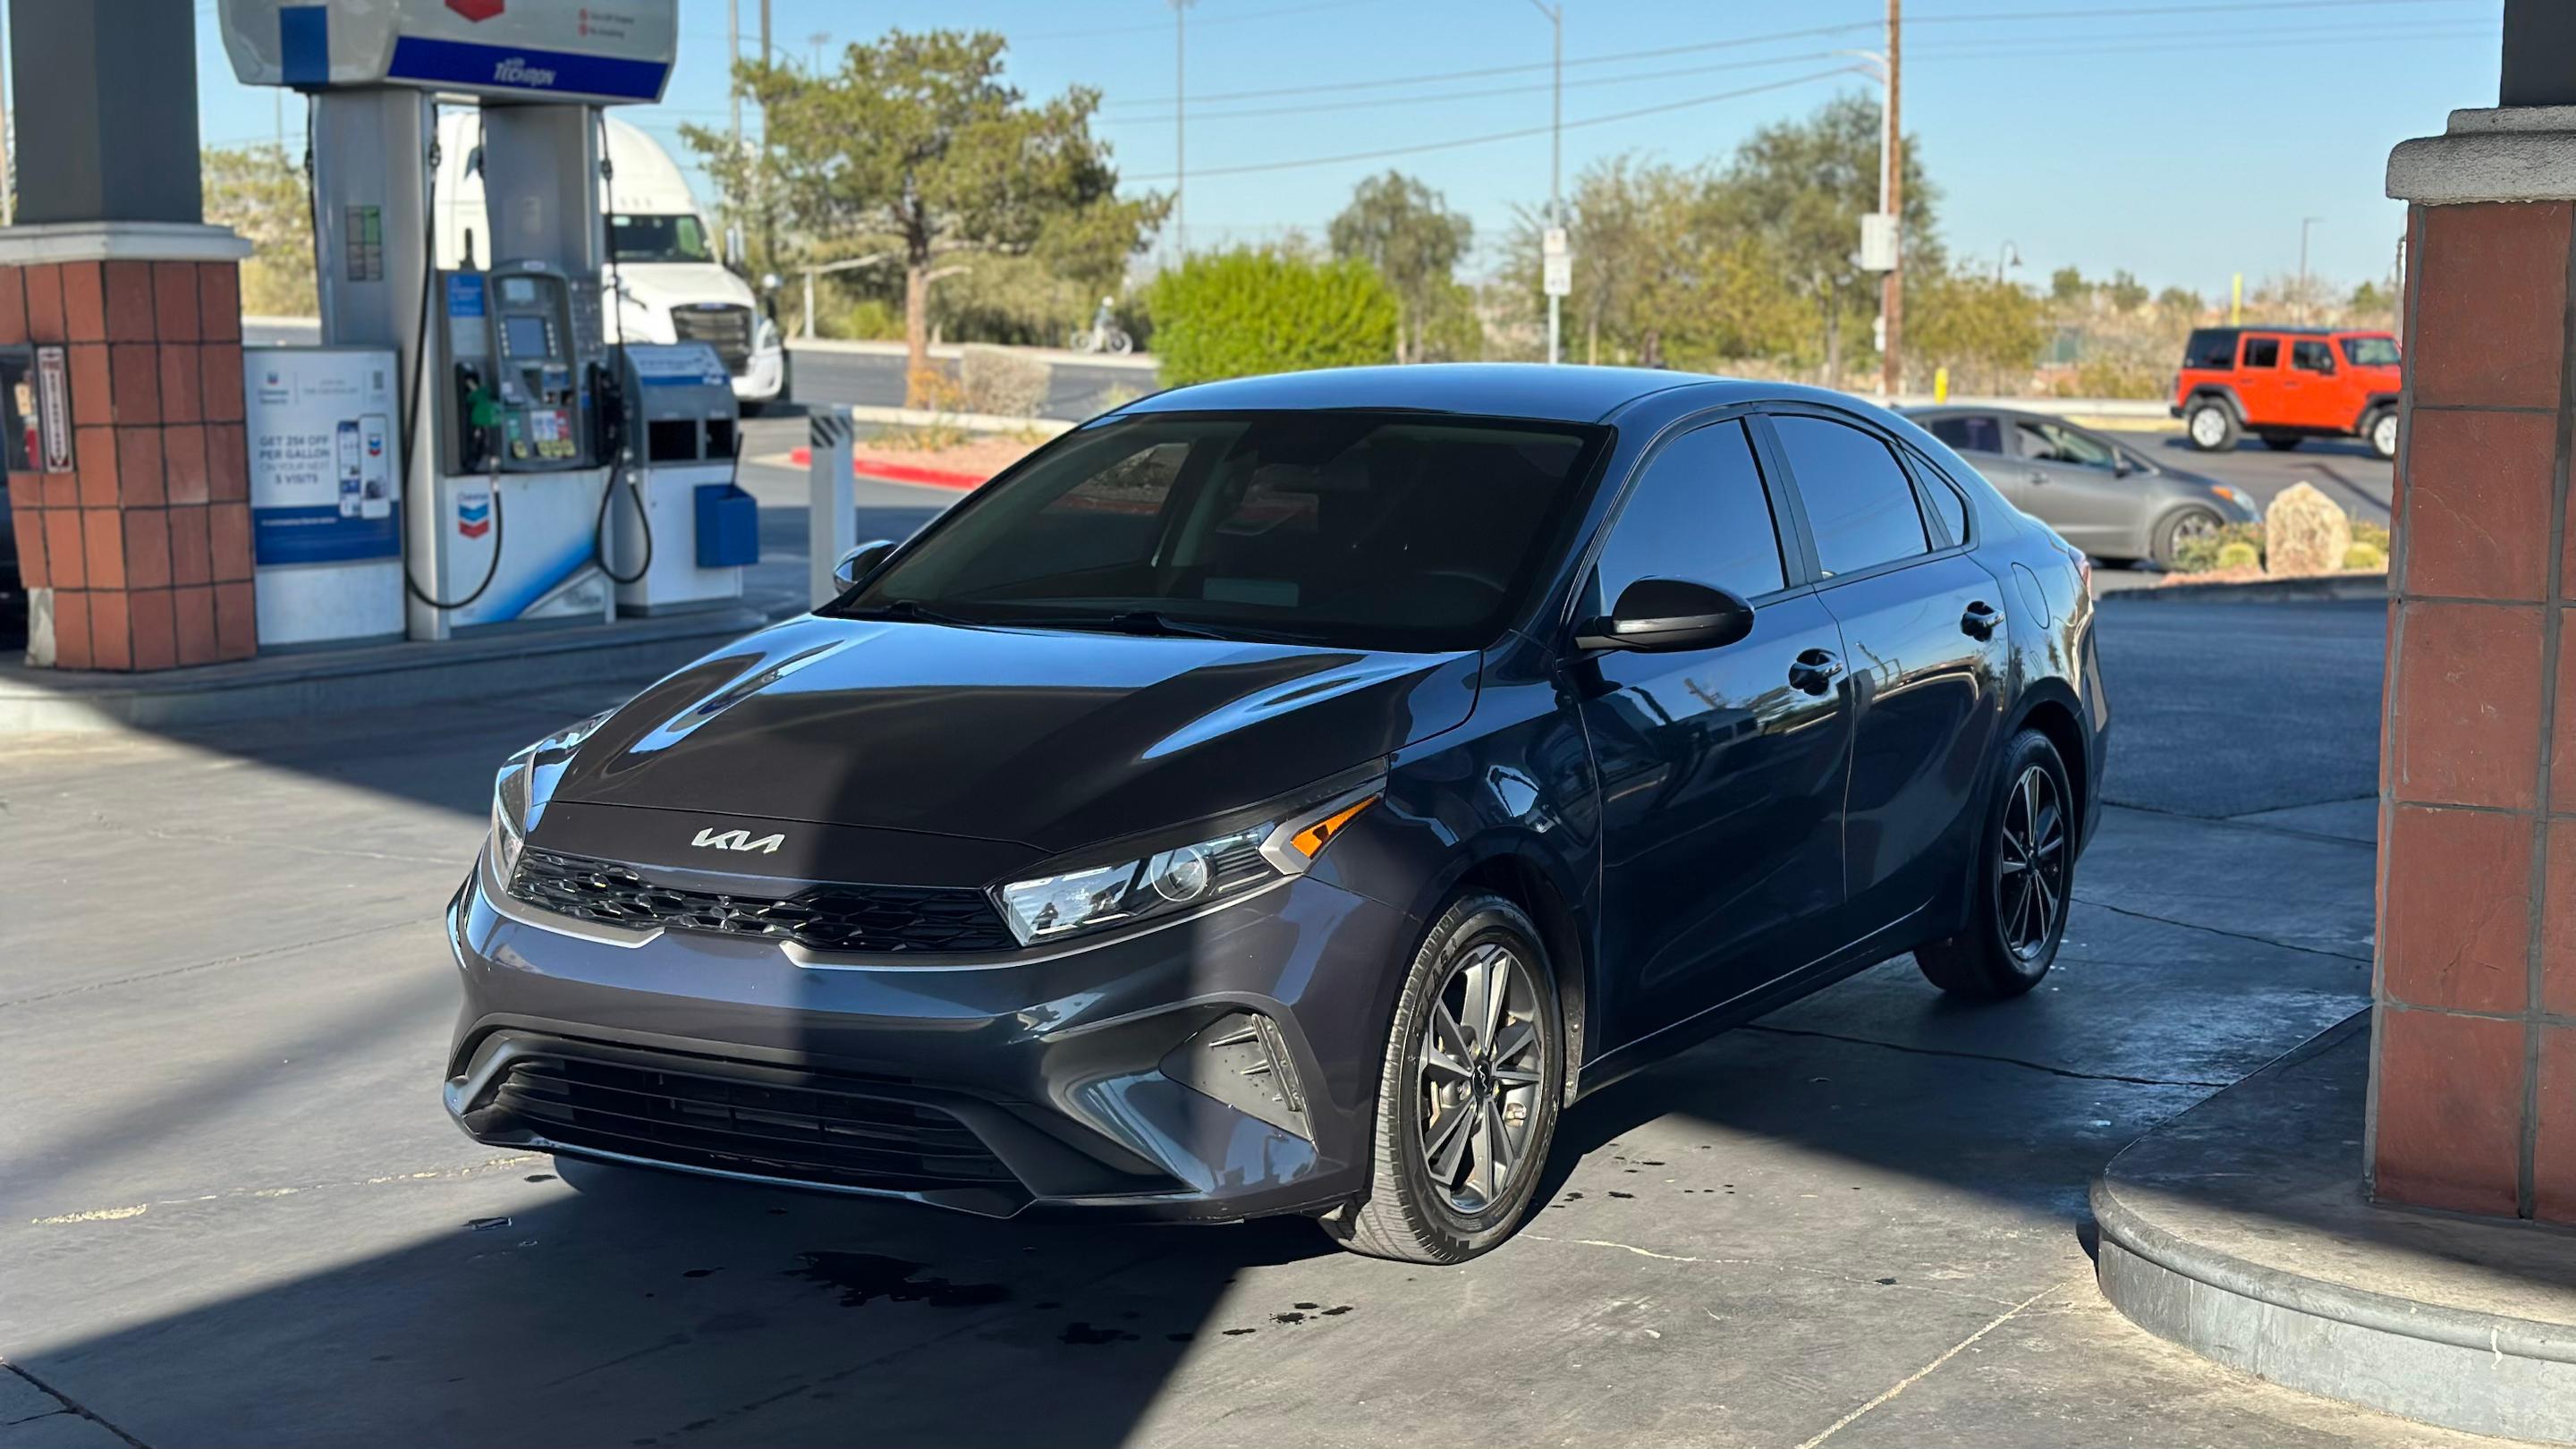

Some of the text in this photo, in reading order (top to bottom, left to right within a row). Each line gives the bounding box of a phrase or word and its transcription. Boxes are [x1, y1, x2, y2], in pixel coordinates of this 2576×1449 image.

[259, 436, 283, 446] GET
[308, 435, 330, 445] OFF
[259, 448, 331, 460] PER GALLON
[284, 473, 319, 485] VISITS
[691, 826, 786, 854] KIA
